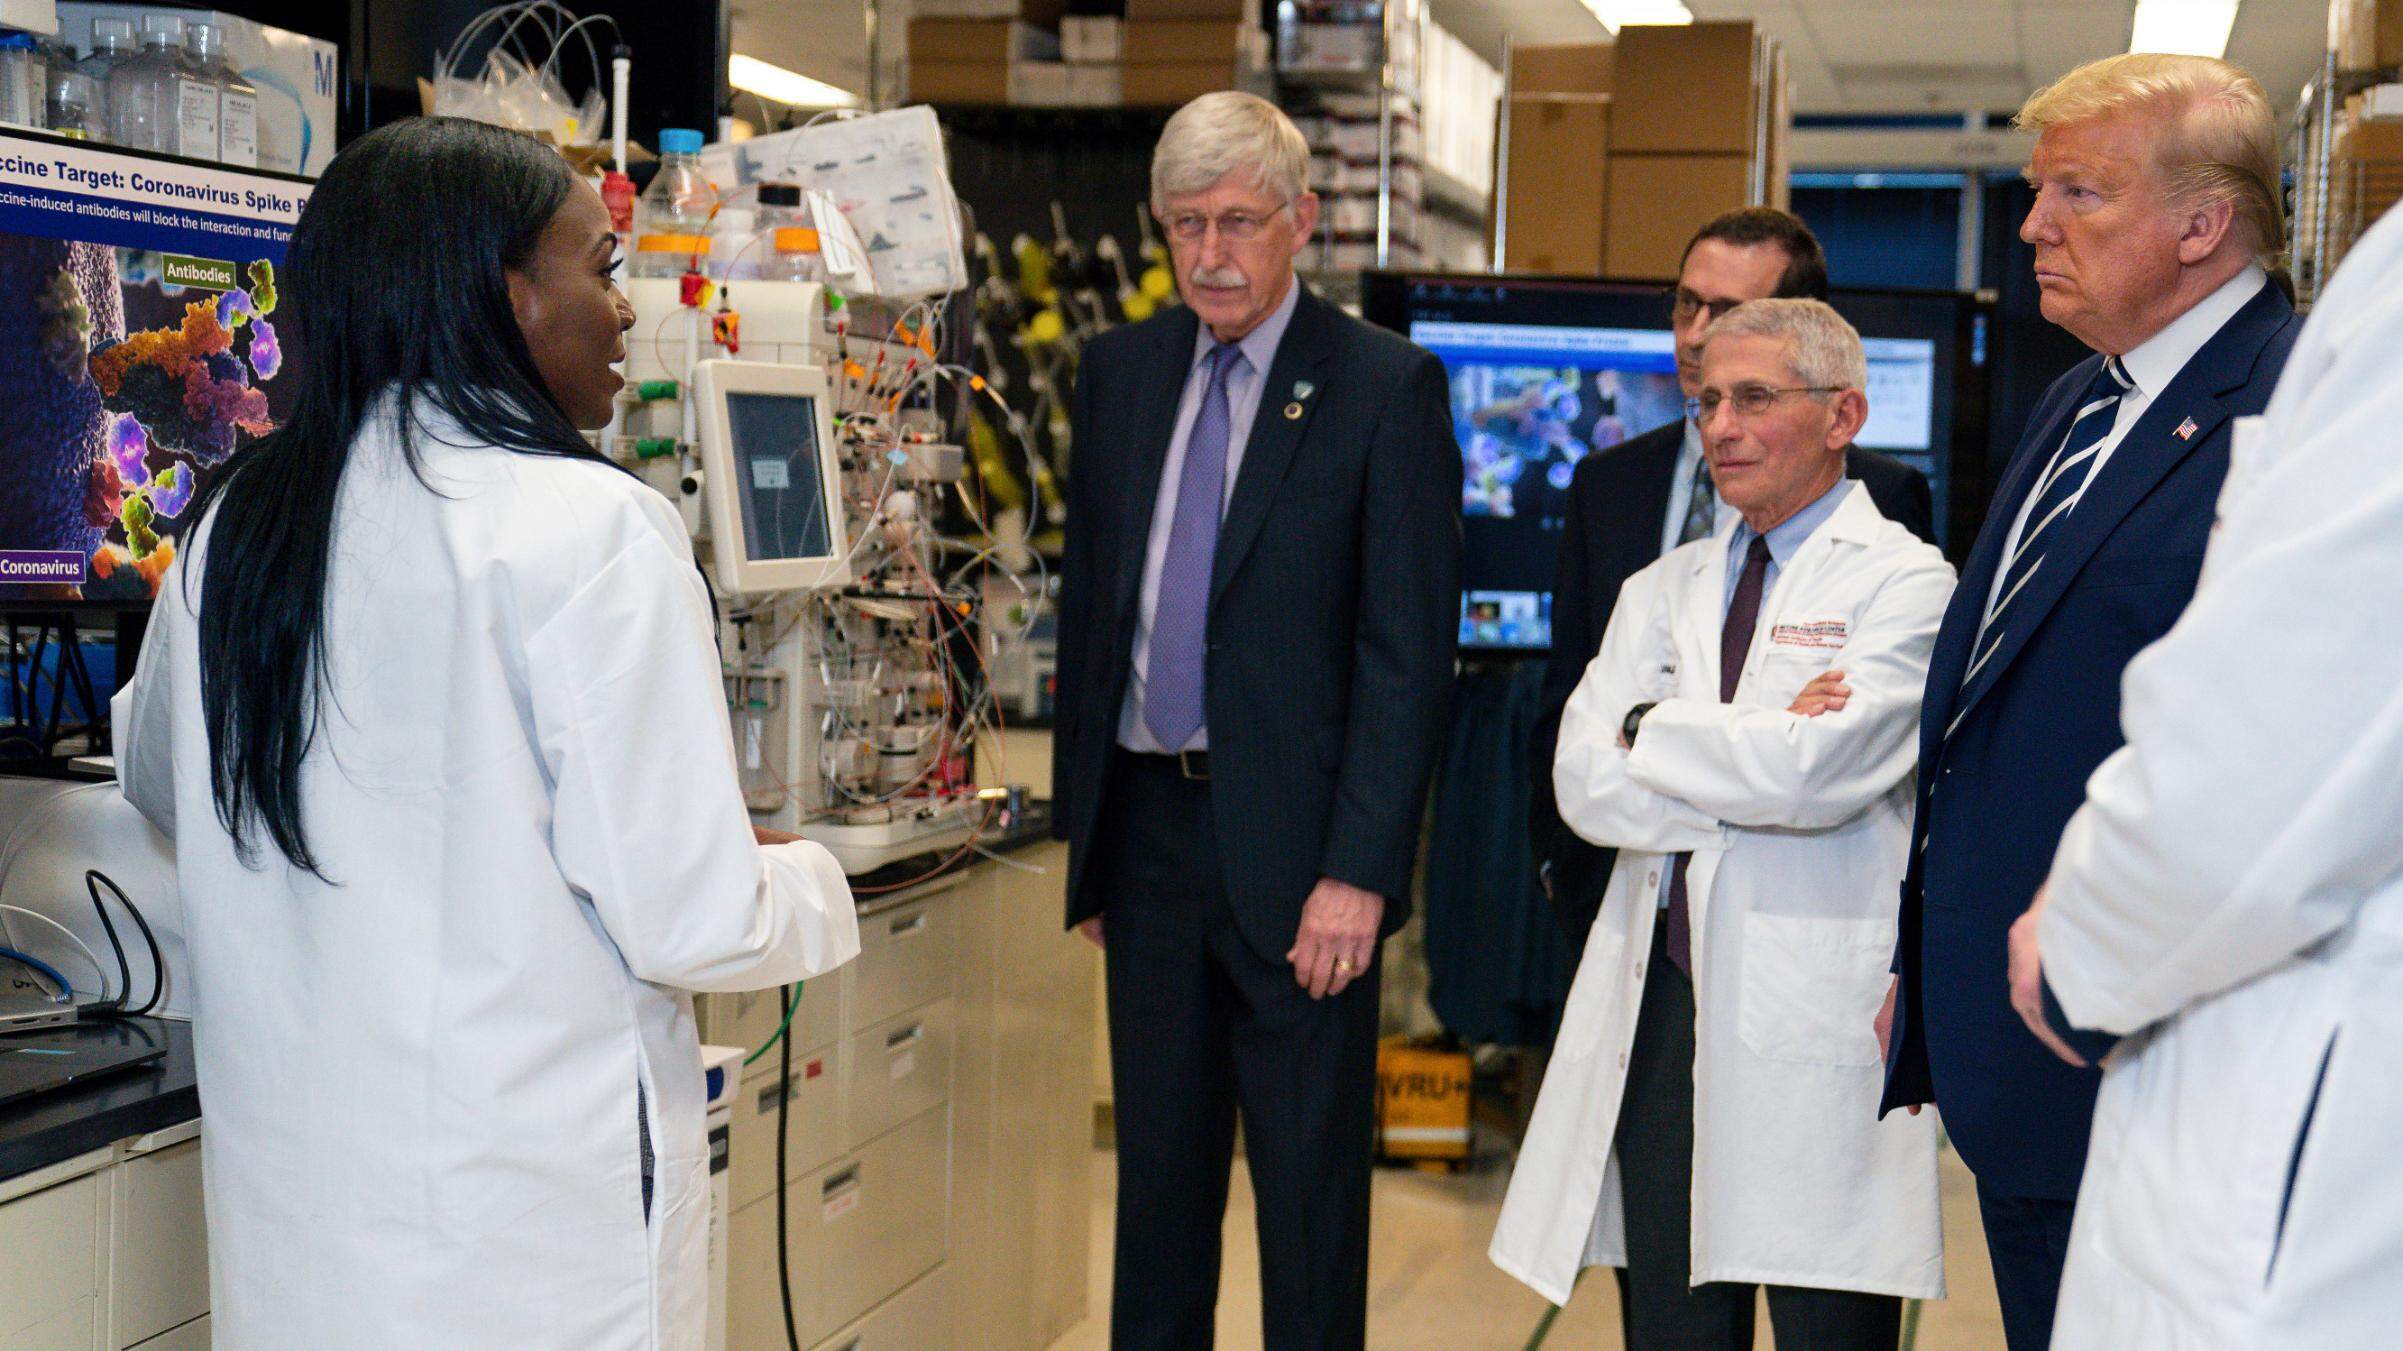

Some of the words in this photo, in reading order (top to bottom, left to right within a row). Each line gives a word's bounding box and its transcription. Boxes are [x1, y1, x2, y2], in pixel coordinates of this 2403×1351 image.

[315, 51, 332, 97] M
[54, 161, 124, 189] Target:
[131, 173, 240, 205] Coronavirus
[245, 190, 291, 213] Spike
[76, 203, 130, 220] antibodies
[132, 209, 150, 223] will
[152, 211, 180, 227] block
[181, 215, 198, 229] the
[200, 218, 251, 236] interaction
[253, 226, 271, 239] and
[167, 262, 231, 284] Antibodies
[0, 559, 80, 575] Coronavirus
